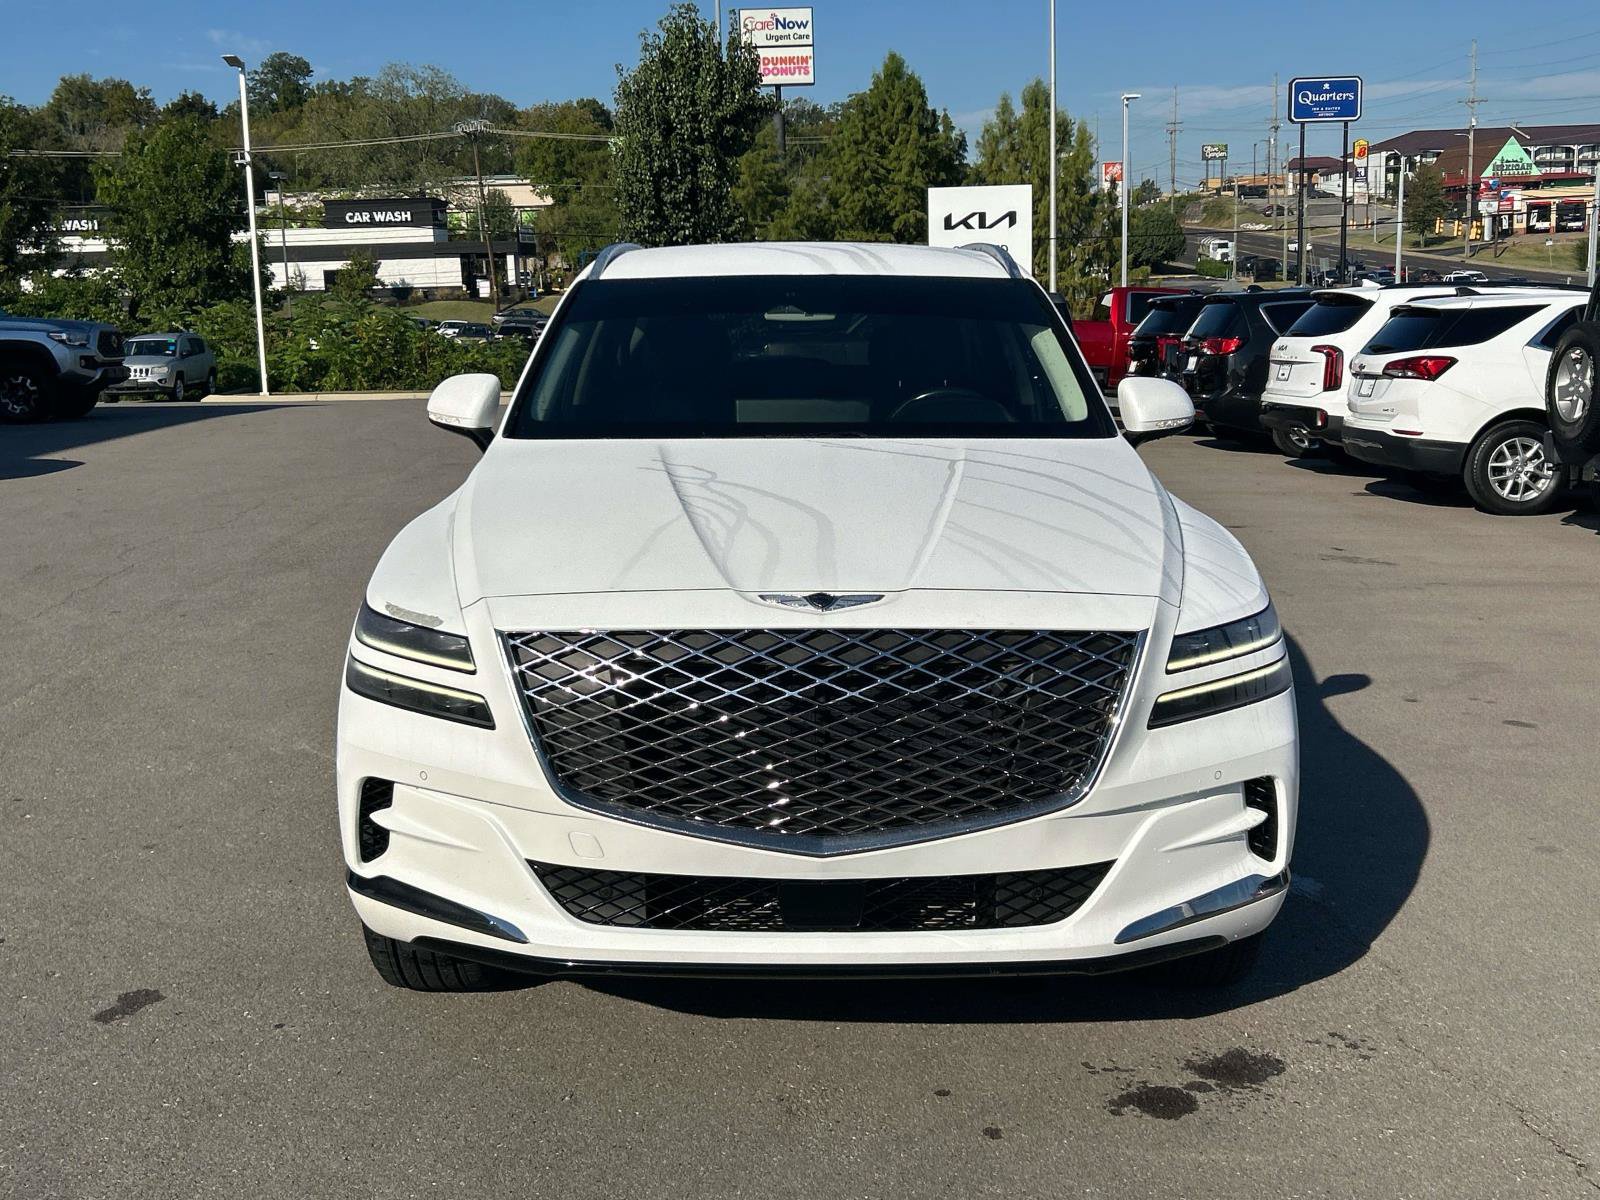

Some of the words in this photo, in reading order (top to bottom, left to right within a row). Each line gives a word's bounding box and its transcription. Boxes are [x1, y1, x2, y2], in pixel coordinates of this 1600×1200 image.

[743, 16, 809, 31] CareNow
[765, 33, 791, 42] Urgent
[762, 66, 810, 76] DONUTS
[1298, 90, 1354, 105] Quarters
[345, 212, 371, 223] CAR
[373, 211, 412, 222] WASH
[944, 210, 1017, 230] KIA
